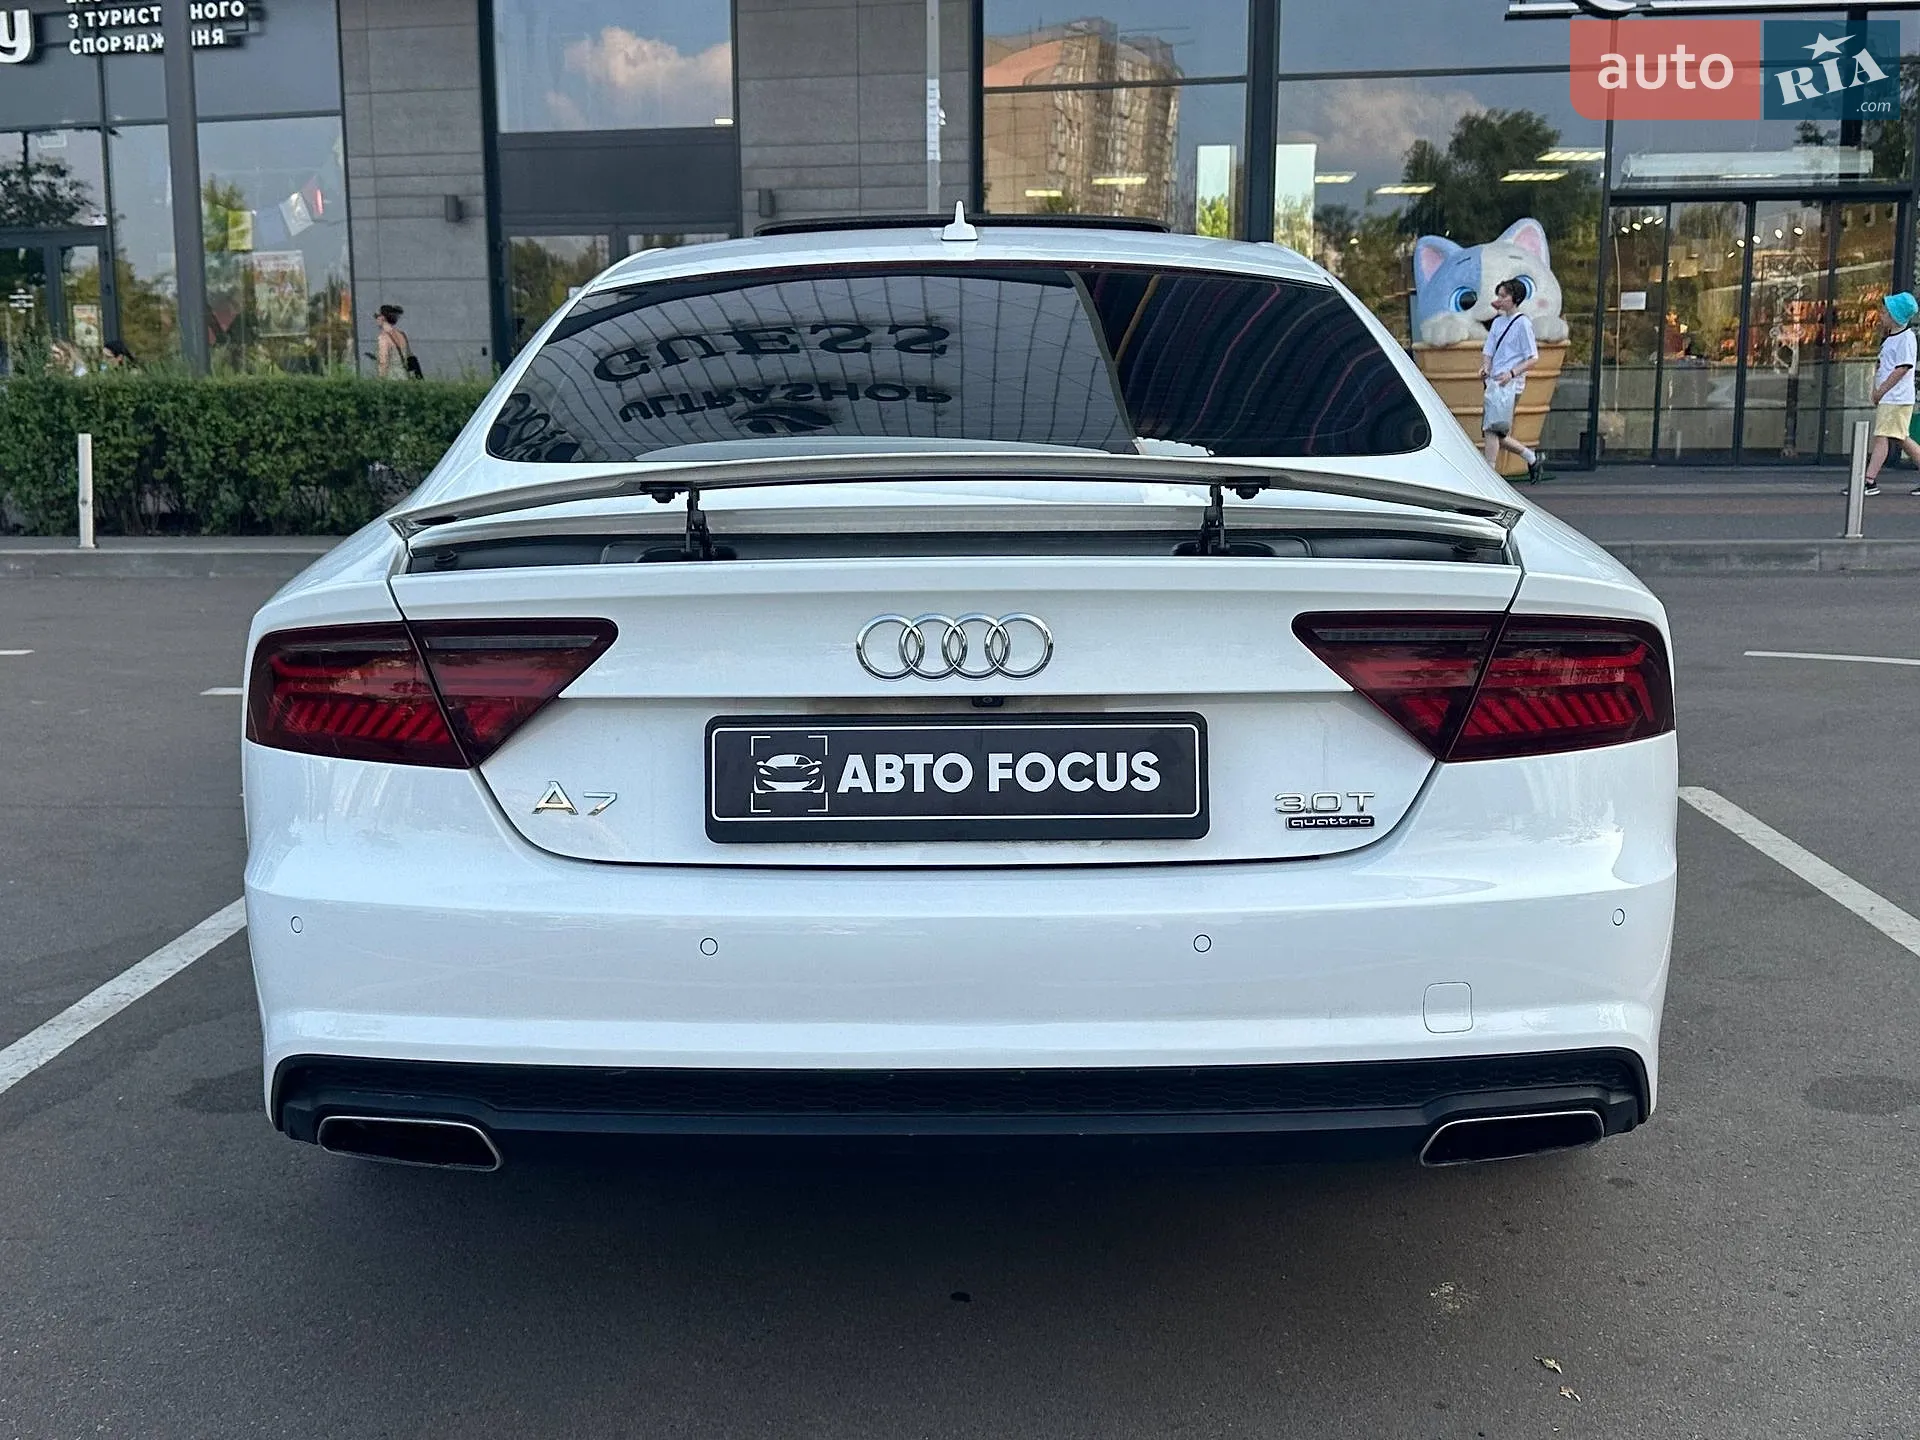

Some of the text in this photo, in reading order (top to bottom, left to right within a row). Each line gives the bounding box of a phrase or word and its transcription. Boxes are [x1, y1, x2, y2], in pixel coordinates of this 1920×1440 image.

[84, 1, 245, 28] ТУРИСТНОГО
[69, 28, 224, 55] СПОРЯДЖНЯ
[836, 751, 1162, 794] АВТО FOCUS
[532, 780, 618, 816] A7
[1291, 818, 1371, 828] quattro
